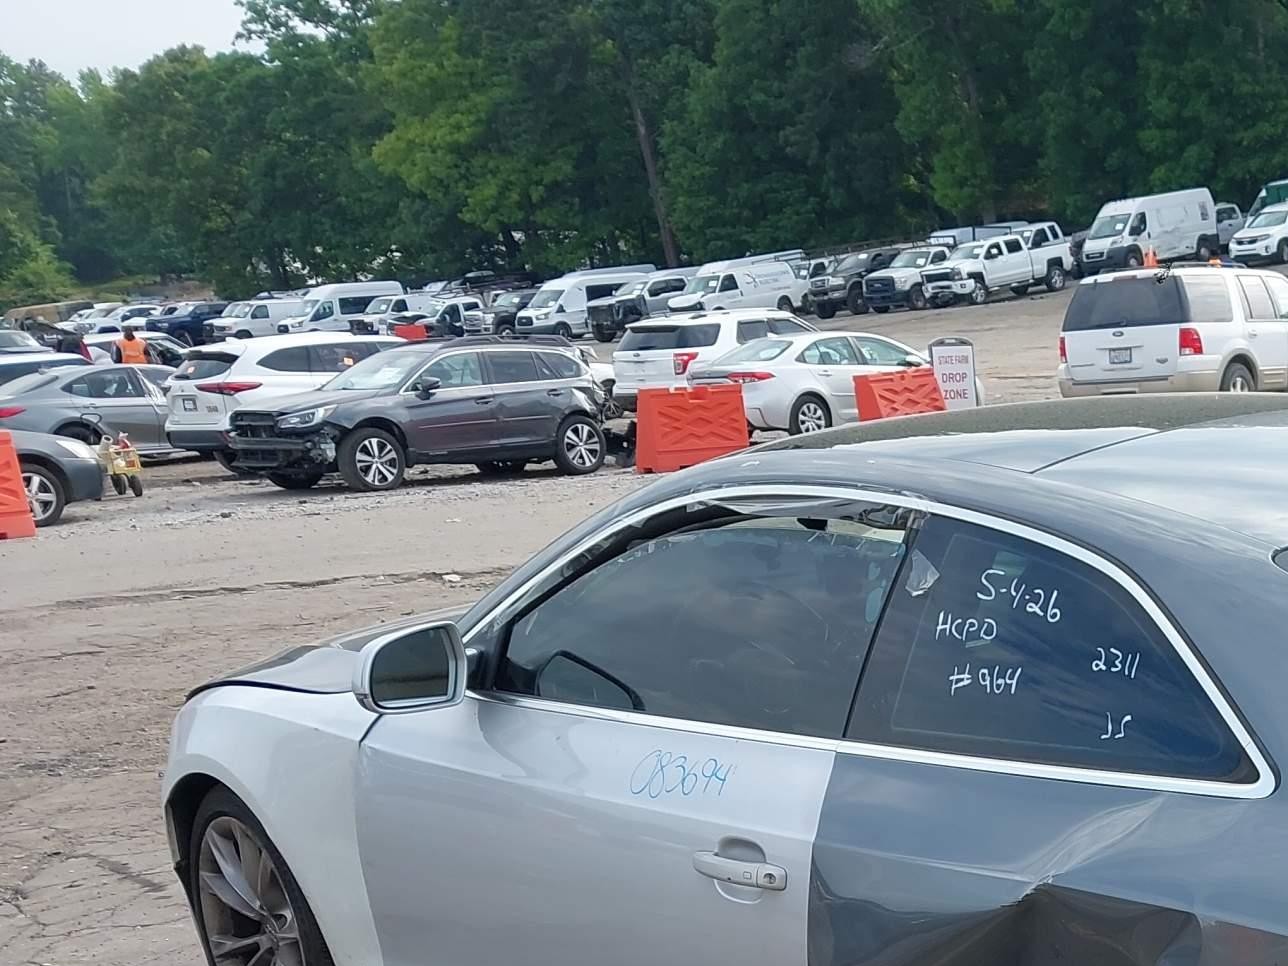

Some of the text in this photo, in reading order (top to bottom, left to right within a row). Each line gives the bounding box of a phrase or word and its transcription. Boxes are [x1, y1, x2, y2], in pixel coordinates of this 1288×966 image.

[942, 372, 968, 383] DROP
[943, 388, 969, 400] ZONE
[935, 610, 998, 641] HCPD
[1091, 647, 1140, 679] 2311
[630, 749, 733, 799] 083694
